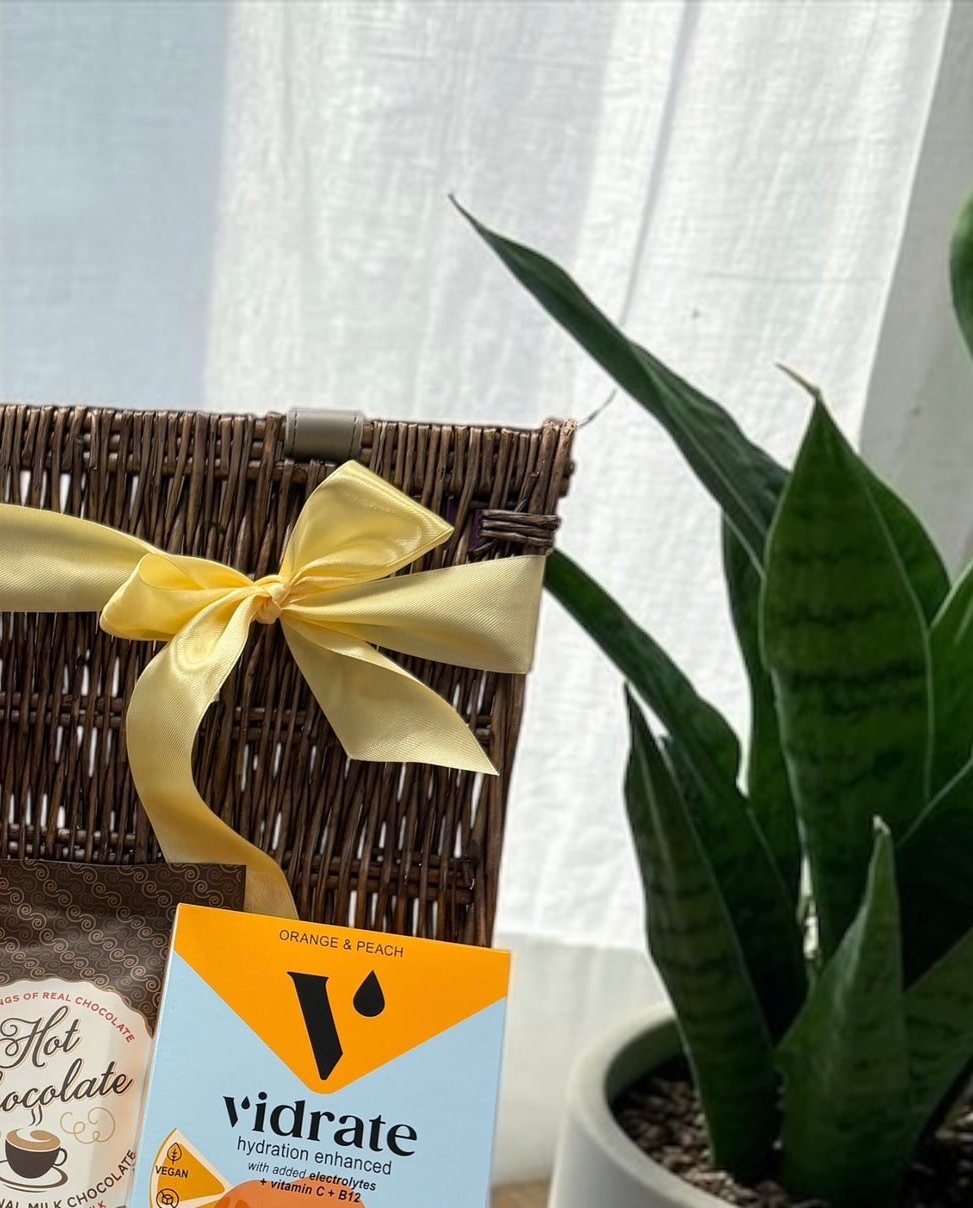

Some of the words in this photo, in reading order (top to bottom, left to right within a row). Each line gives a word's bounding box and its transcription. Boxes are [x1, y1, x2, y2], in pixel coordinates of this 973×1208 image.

[279, 929, 338, 951] ORANGE
[340, 939, 353, 951] &
[357, 940, 404, 958] PEACH
[23, 992, 39, 1000] OF
[42, 992, 71, 1002] REAL
[75, 996, 134, 1043] CHOCOLATE
[223, 1091, 418, 1158] vidrate
[155, 1165, 189, 1179] VEGAN
[237, 1136, 308, 1162] hydration
[314, 1149, 392, 1176] enhanced
[67, 1149, 136, 1208] CHOCOLATE
[248, 1160, 269, 1174] with
[272, 1163, 307, 1180] added
[309, 1169, 377, 1192] electrolytes
[260, 1178, 267, 1186] +
[270, 1178, 312, 1196] vitamin
[315, 1185, 325, 1197] C
[338, 1190, 362, 1204] B12
